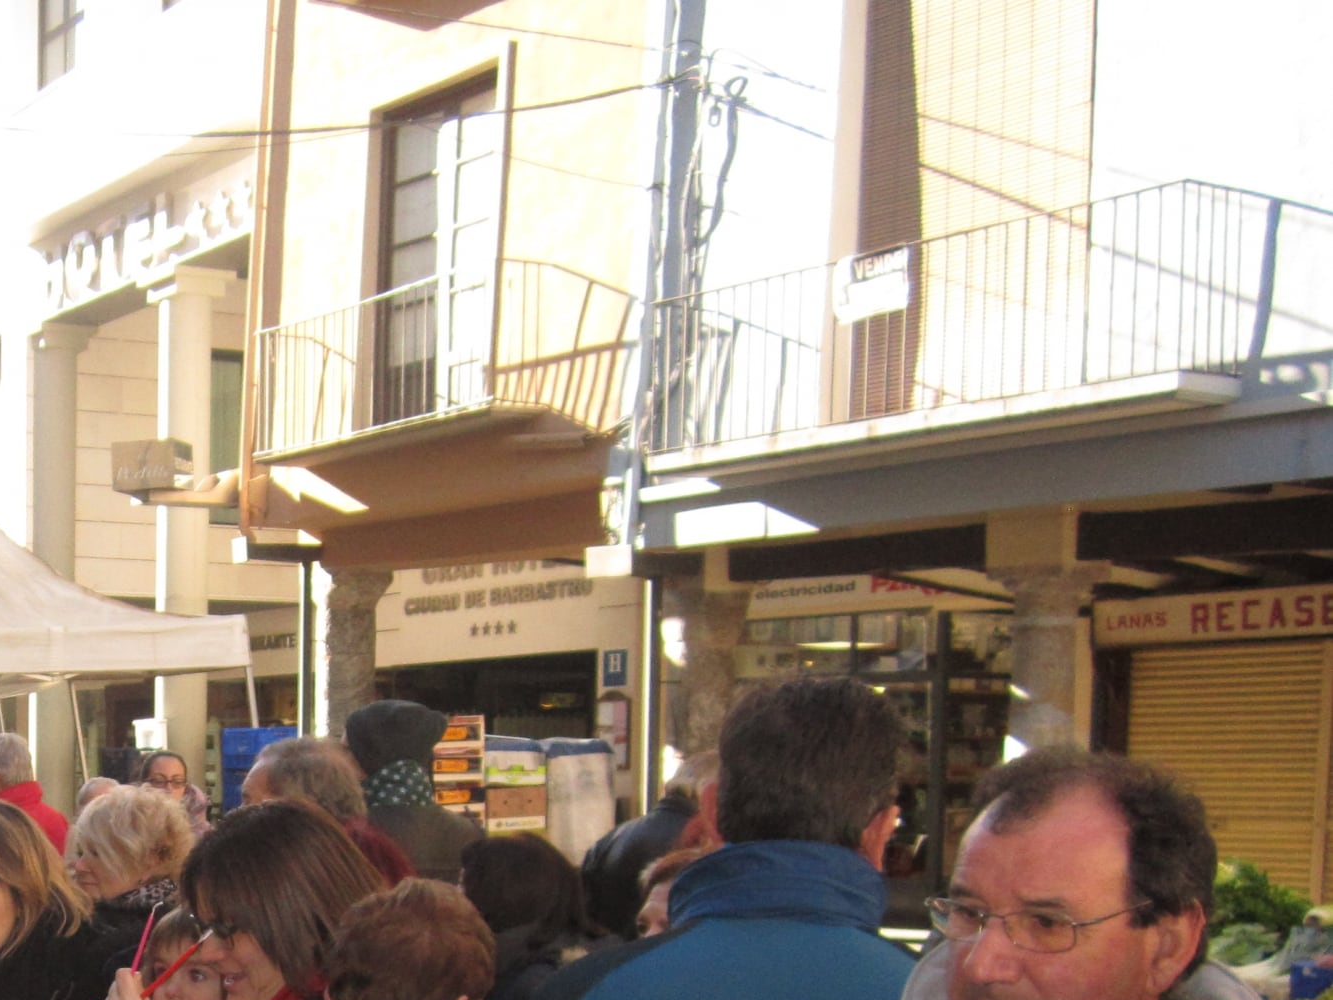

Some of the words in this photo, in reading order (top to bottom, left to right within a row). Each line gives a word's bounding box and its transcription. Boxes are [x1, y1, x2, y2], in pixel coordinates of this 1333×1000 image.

[404, 592, 461, 616] CIUDAD
[465, 589, 487, 609] DE
[489, 578, 594, 607] BARBASTRO
[755, 580, 856, 600] electricidad
[1106, 611, 1167, 631] LANAS
